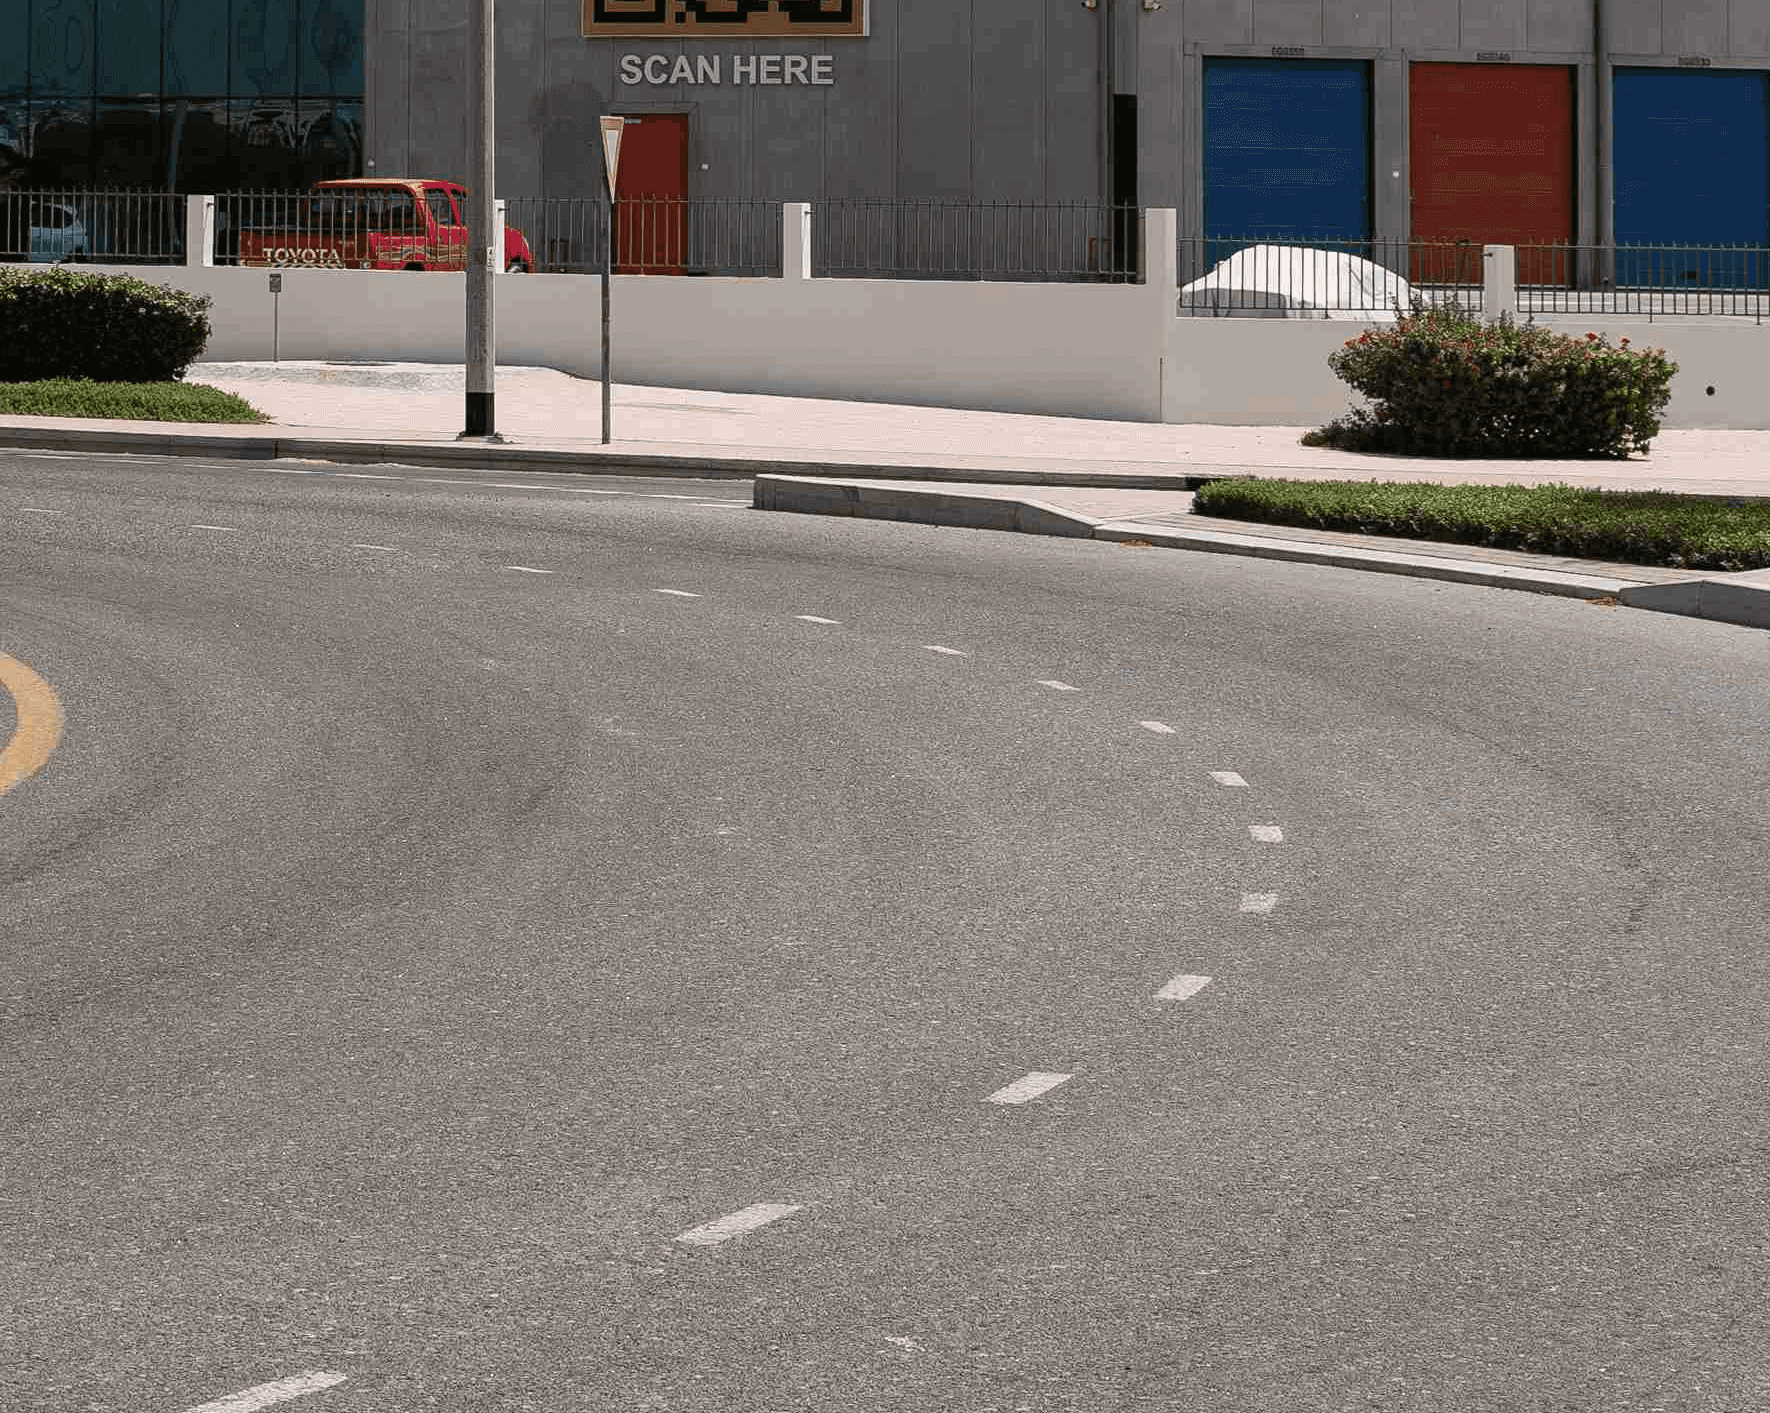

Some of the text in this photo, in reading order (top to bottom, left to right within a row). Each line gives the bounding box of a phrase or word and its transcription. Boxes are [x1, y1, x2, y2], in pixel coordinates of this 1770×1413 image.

[620, 54, 834, 85] SCAN HERE
[262, 247, 342, 265] TOYOTA
